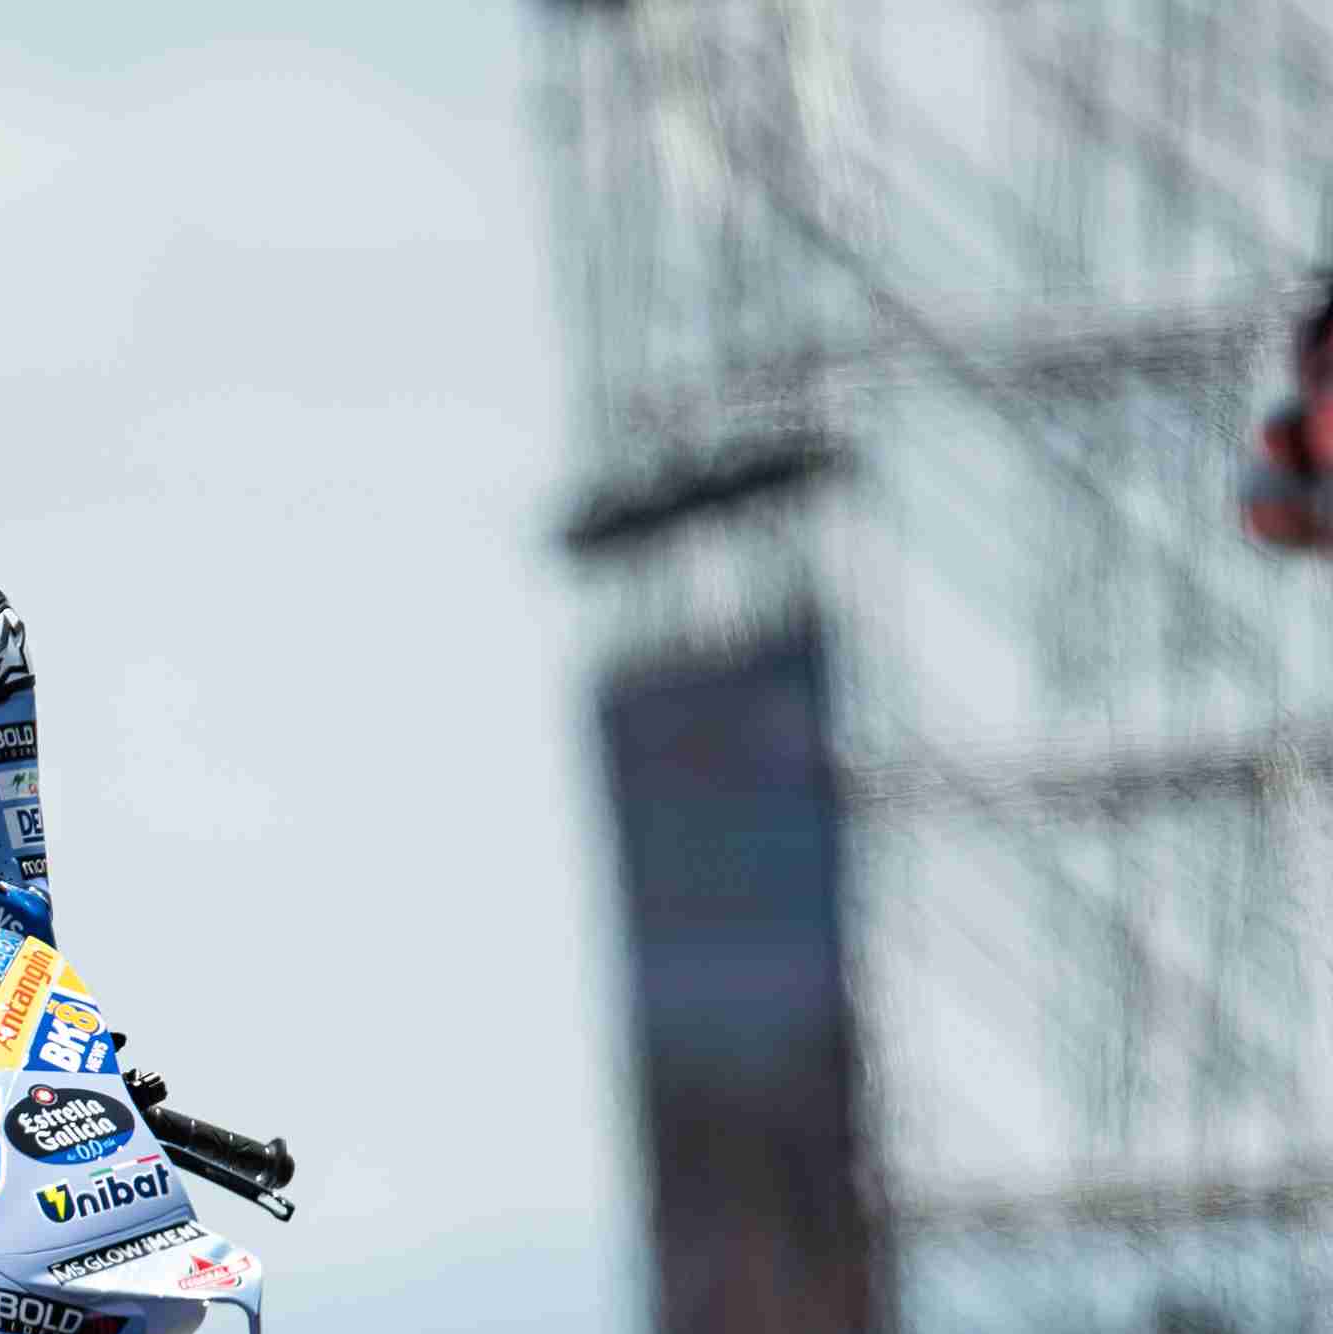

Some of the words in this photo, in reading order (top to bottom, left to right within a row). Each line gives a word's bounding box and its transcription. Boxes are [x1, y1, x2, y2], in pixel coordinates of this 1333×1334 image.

[39, 1000, 100, 1073] BK8
[84, 1039, 109, 1073] NEWS
[17, 1098, 106, 1134] Estrella
[34, 1116, 118, 1151] Galicia
[36, 1162, 170, 1224] Unibat
[52, 1262, 86, 1283] MS
[85, 1239, 145, 1270] GLOW
